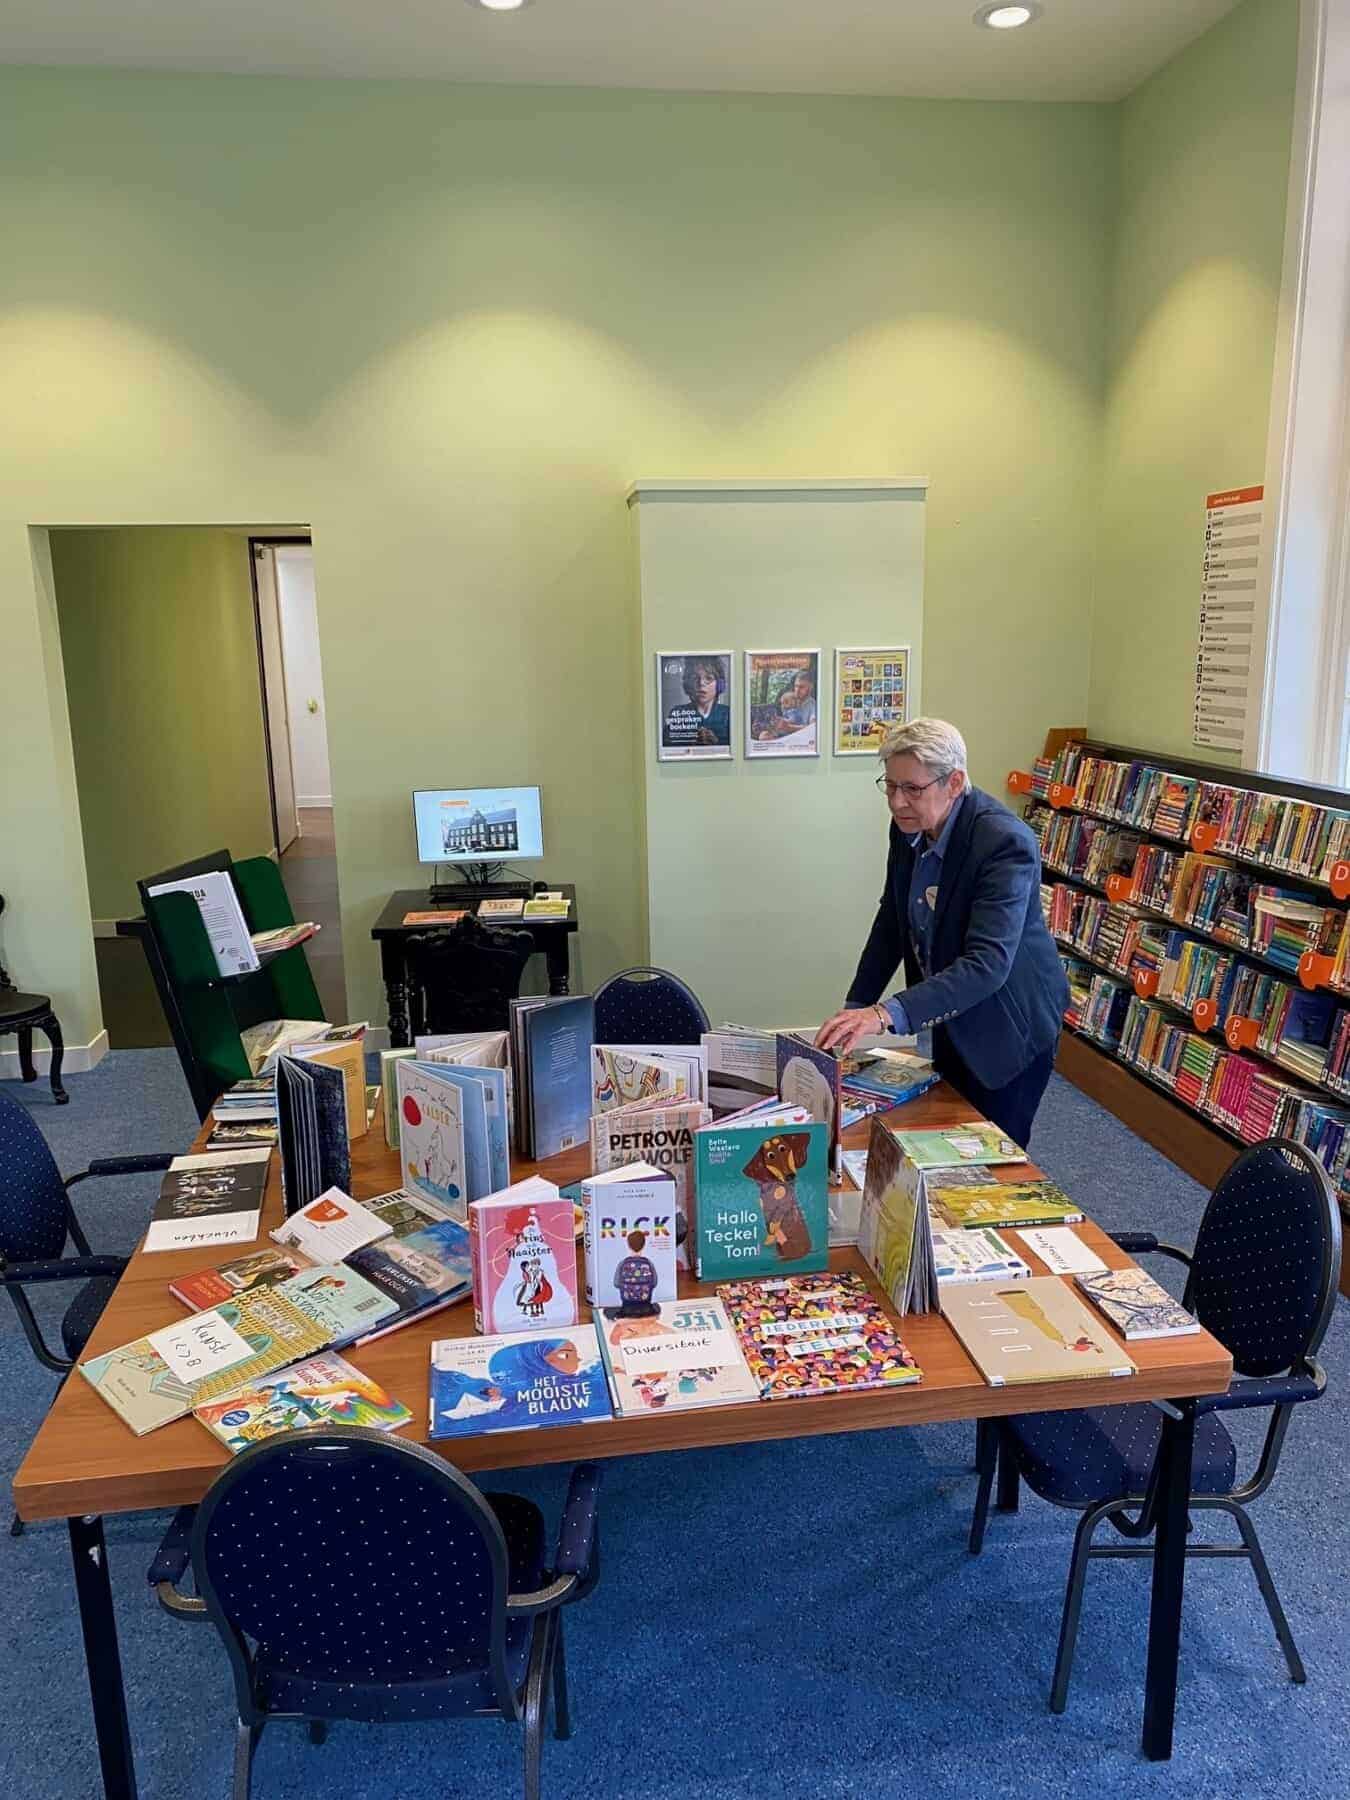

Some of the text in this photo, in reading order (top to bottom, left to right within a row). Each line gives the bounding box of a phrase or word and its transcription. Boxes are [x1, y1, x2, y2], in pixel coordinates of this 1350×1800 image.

[1009, 773, 1018, 785] A
[1052, 785, 1061, 798] B
[1194, 825, 1205, 839] C
[1335, 865, 1349, 881] D
[1109, 876, 1120, 890] H
[1305, 956, 1313, 971] J
[1136, 971, 1149, 985] N
[1195, 1002, 1209, 1016] O
[1232, 1019, 1241, 1031] P
[609, 1128, 693, 1151] PETROVA
[640, 1147, 693, 1166] WOLF
[717, 1209, 758, 1225] Hallo
[600, 1216, 671, 1239] RICK
[705, 1226, 757, 1243] Teckel
[764, 1316, 861, 1334] IEDEREEN
[192, 1320, 232, 1354] Kunst
[797, 1336, 851, 1353] TELT
[534, 1375, 558, 1388] HET
[517, 1381, 593, 1403] MOOISTE
[528, 1396, 590, 1415] BLAUW
